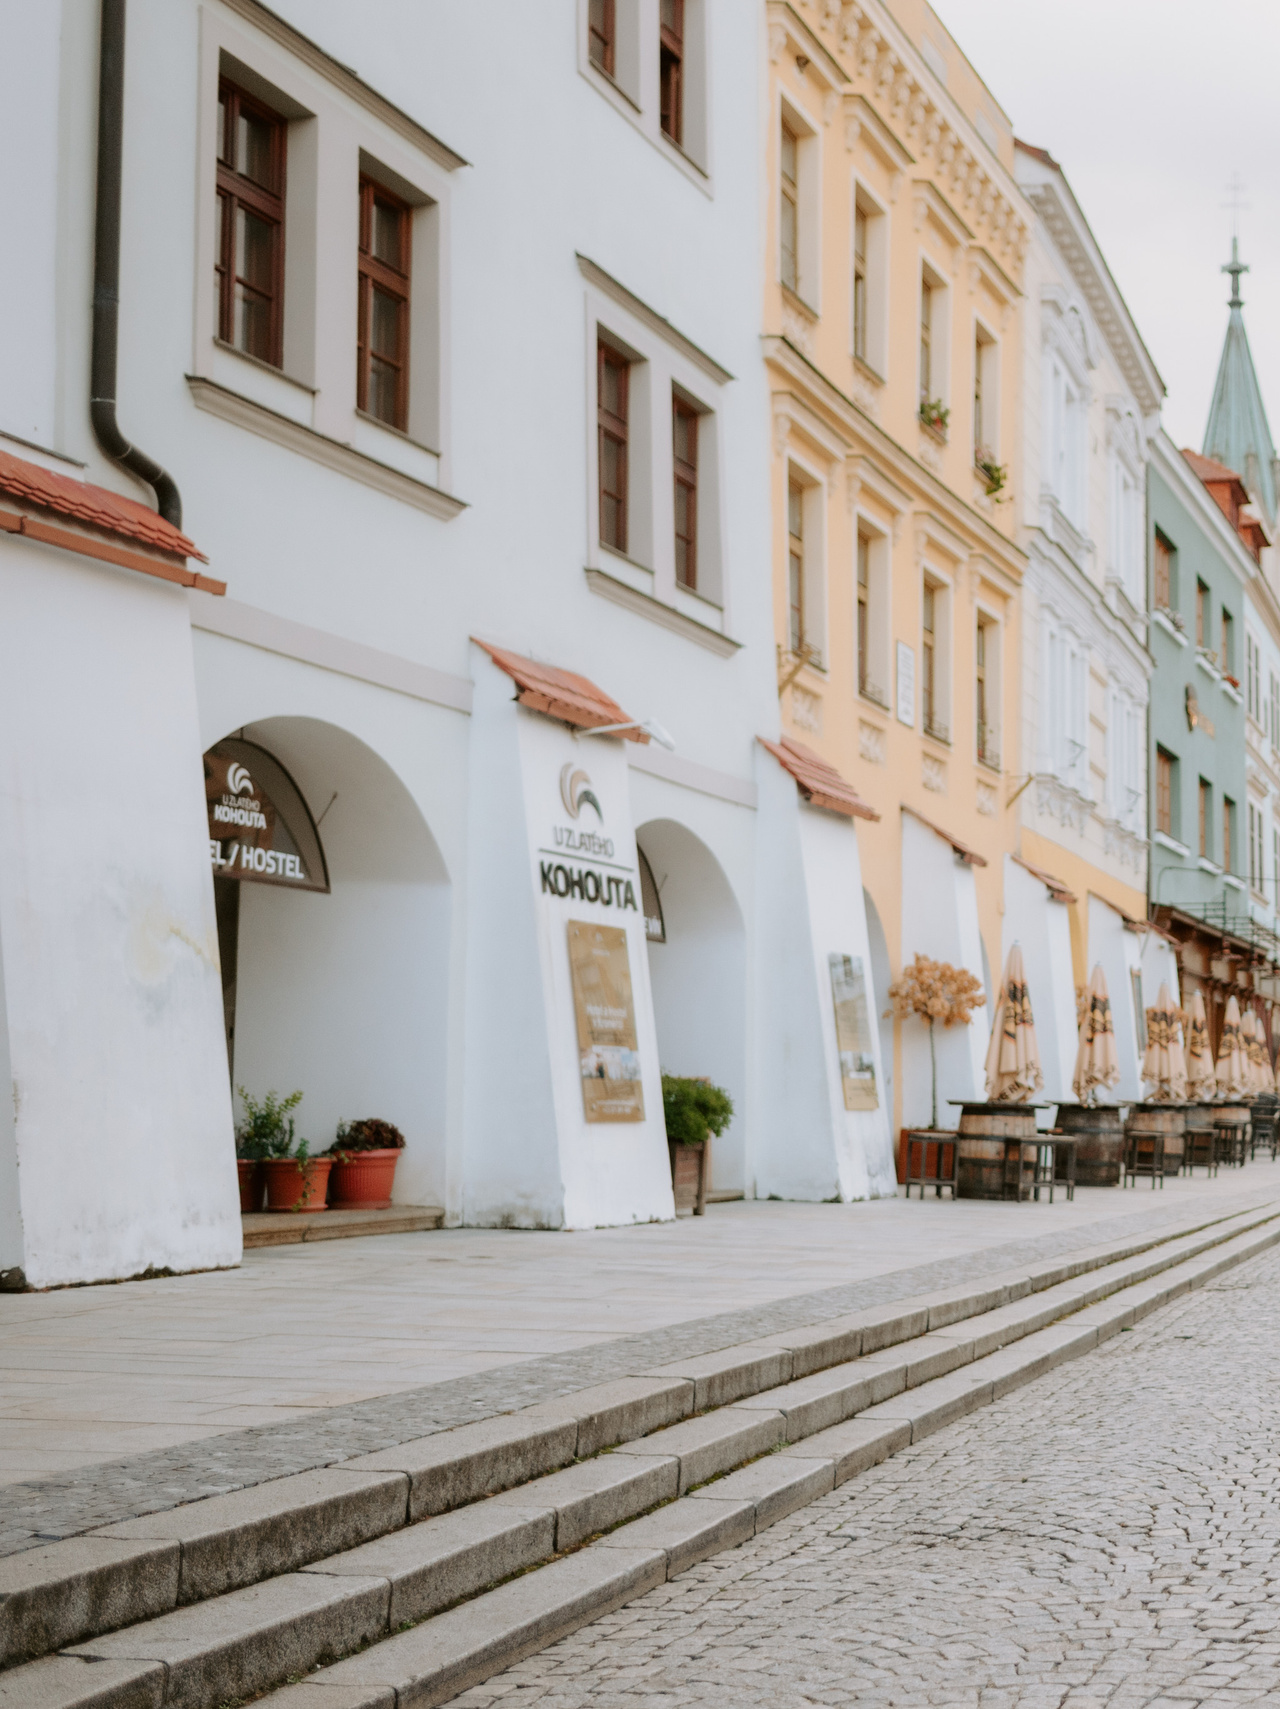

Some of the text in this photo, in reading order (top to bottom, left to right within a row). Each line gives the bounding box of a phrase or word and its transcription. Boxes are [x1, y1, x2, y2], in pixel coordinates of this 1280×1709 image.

[214, 804, 267, 830] KOHOUTA
[553, 825, 615, 858] U ZLATÉHO
[242, 845, 304, 879] HOSTEL
[540, 860, 638, 911] KOHOUTA
